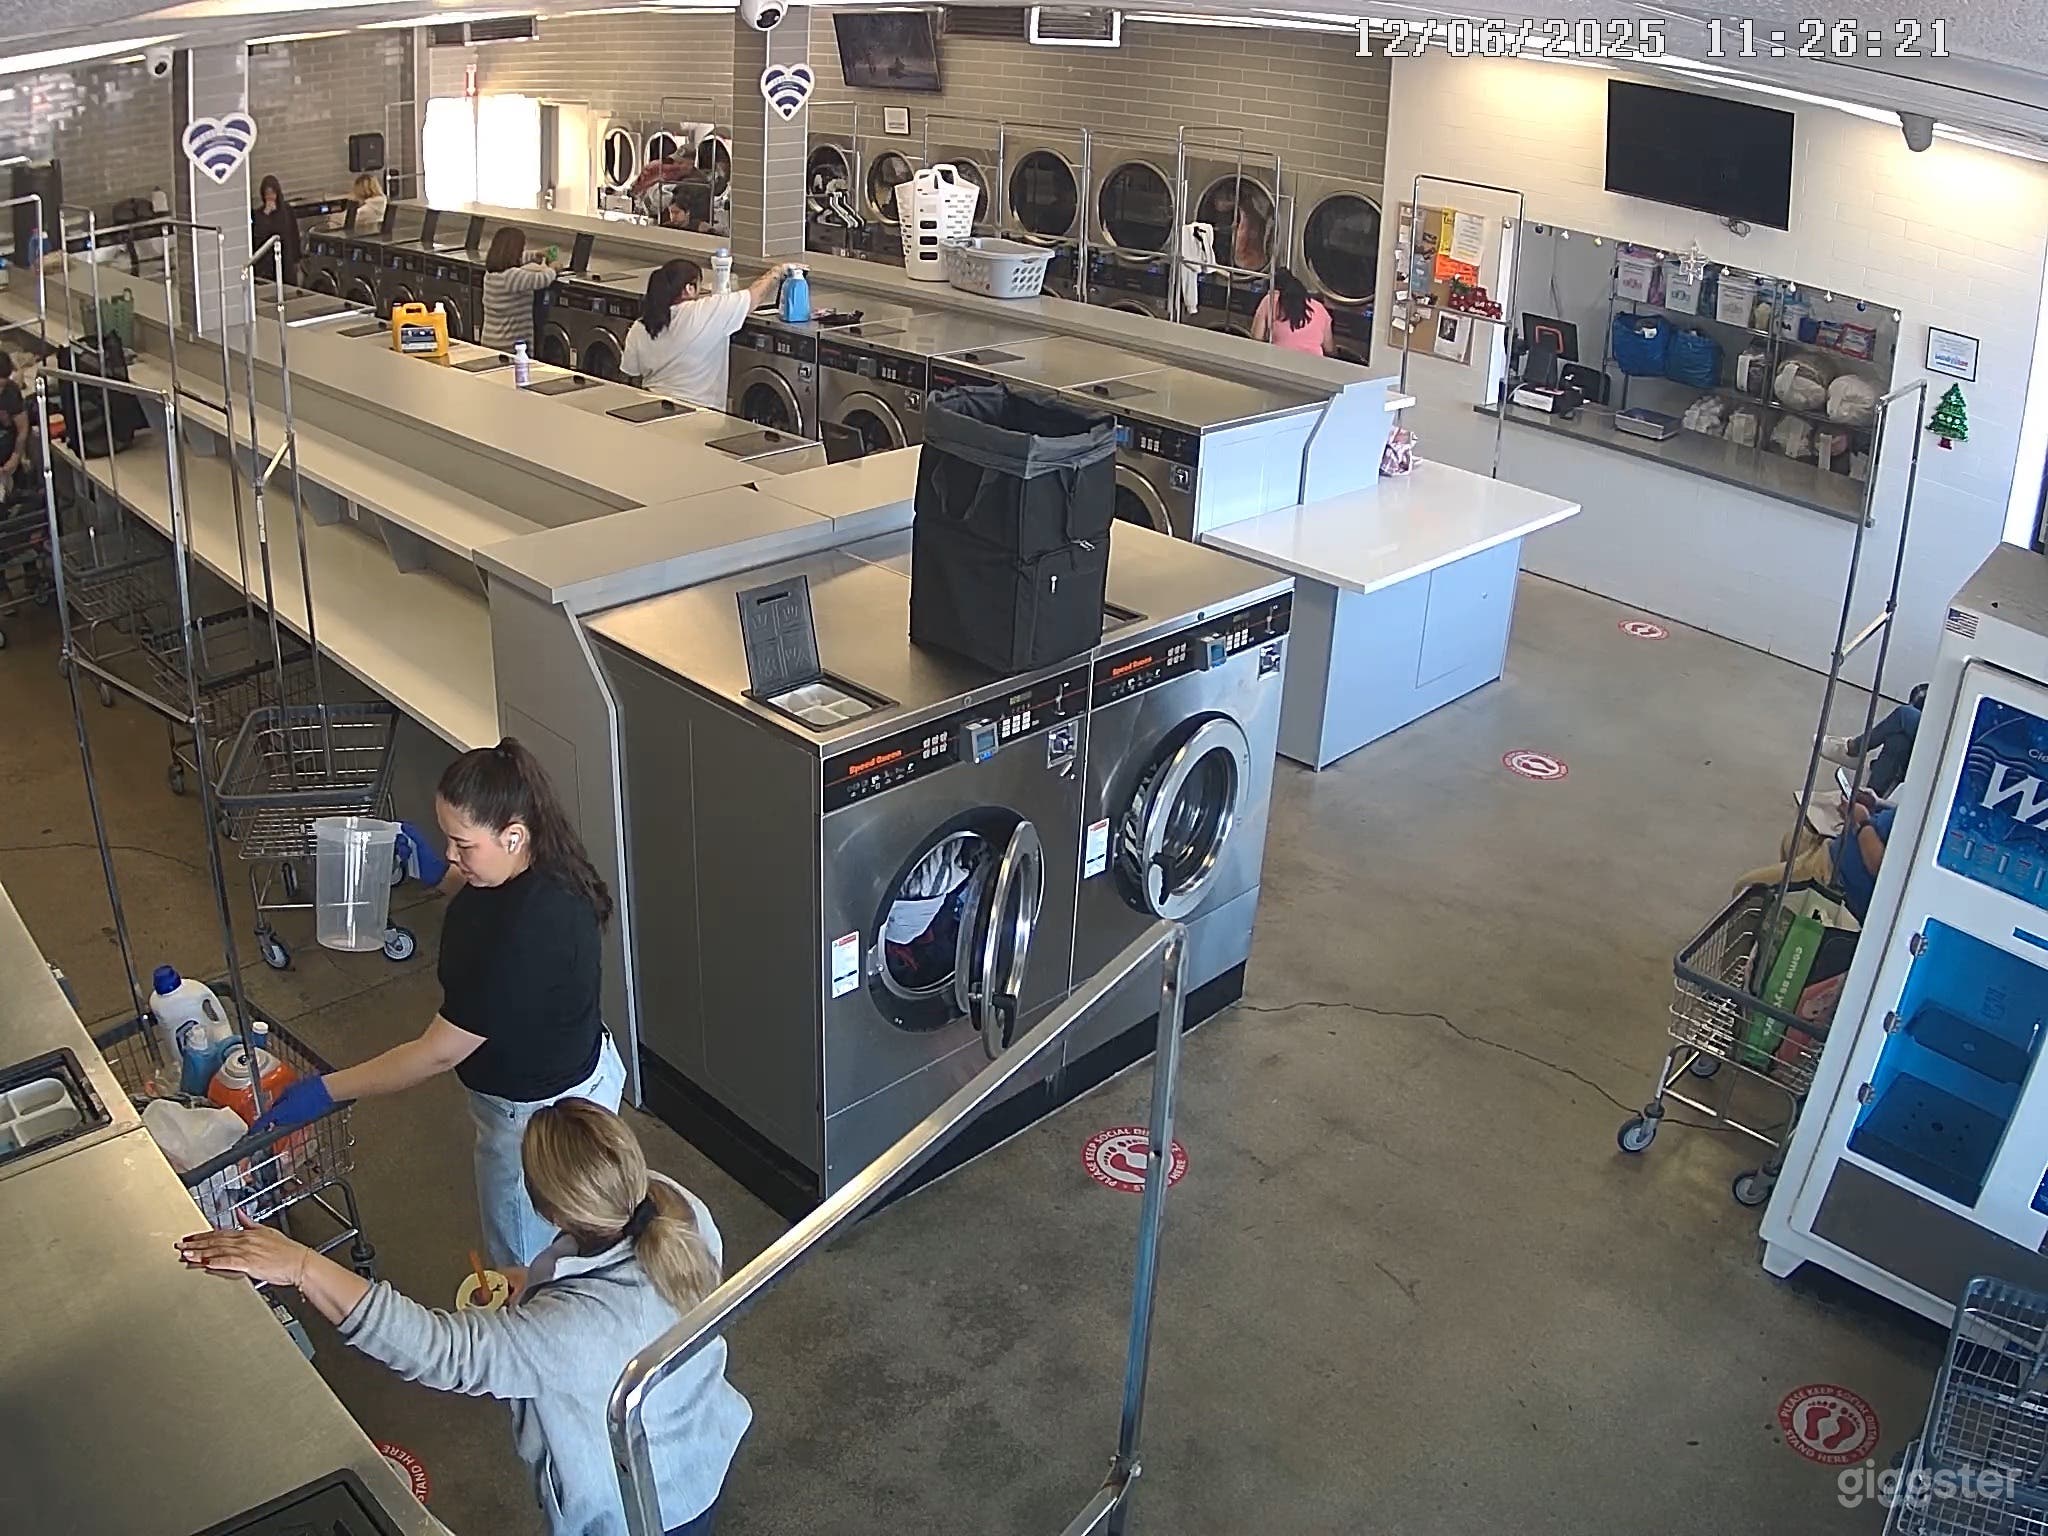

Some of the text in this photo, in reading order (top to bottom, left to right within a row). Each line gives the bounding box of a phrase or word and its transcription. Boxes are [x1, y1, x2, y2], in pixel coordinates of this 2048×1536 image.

[848, 749, 902, 776] Speed Queen
[1095, 1128, 1131, 1144] SOCIAL
[1780, 1390, 1806, 1417] PLEASE
[1806, 1386, 1834, 1396] KEEP
[1835, 1389, 1866, 1414] SOCIAL
[1784, 1429, 1849, 1463] STAND HERE
[381, 1444, 427, 1502] STAND HERE
